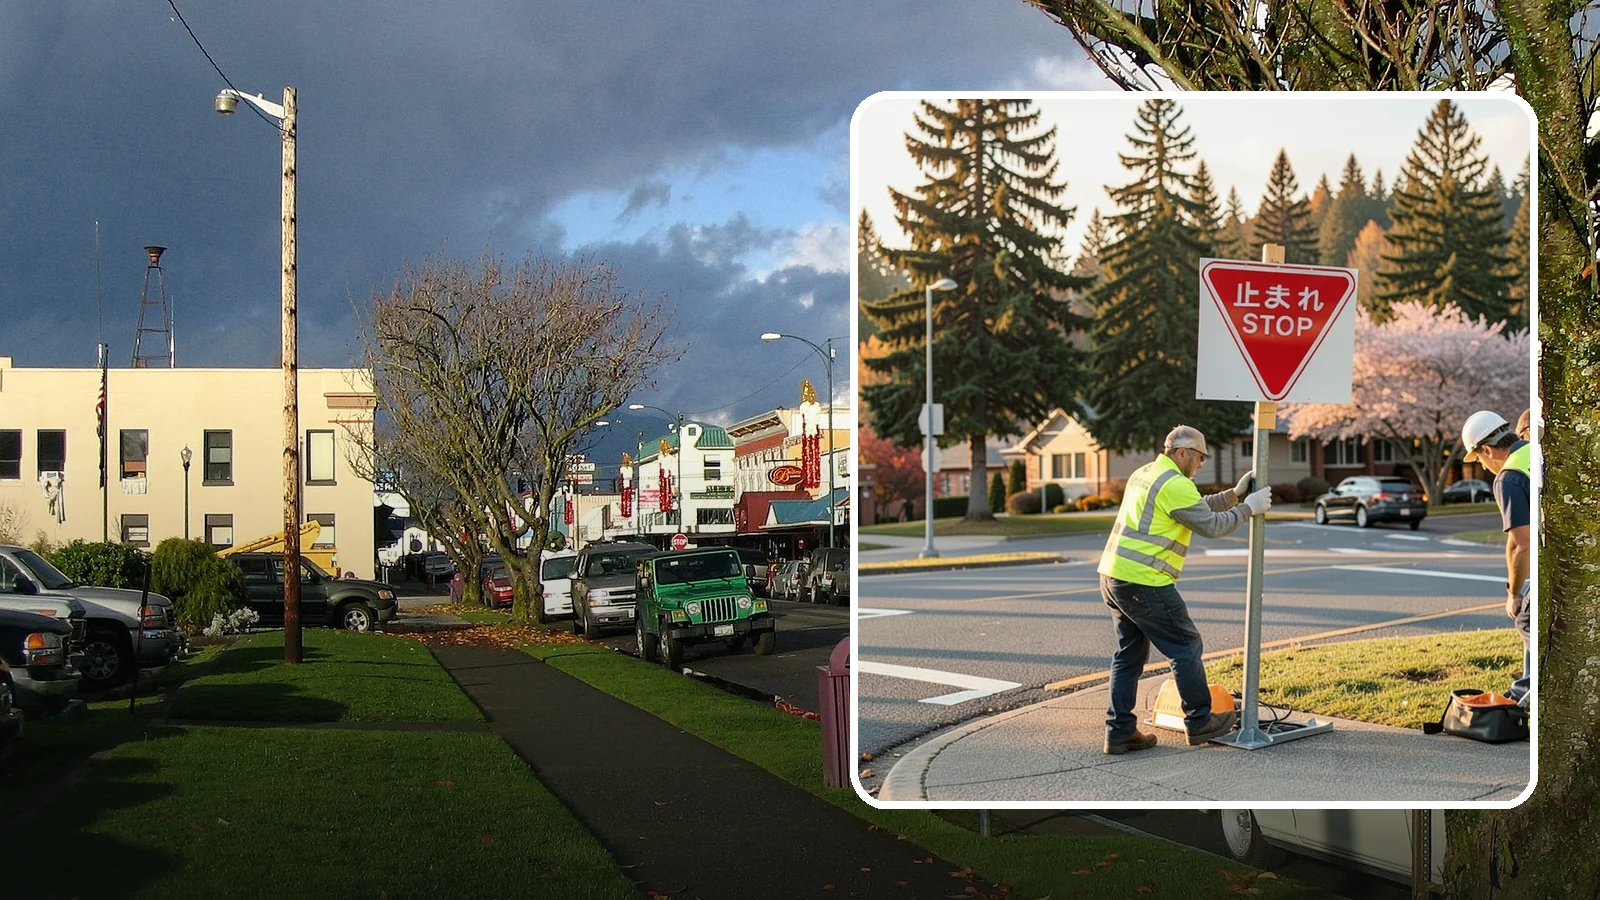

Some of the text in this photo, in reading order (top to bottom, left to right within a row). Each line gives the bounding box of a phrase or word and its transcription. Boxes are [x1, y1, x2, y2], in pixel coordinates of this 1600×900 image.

[1233, 281, 1324, 311] 止まれ
[1242, 312, 1313, 336] STOP
